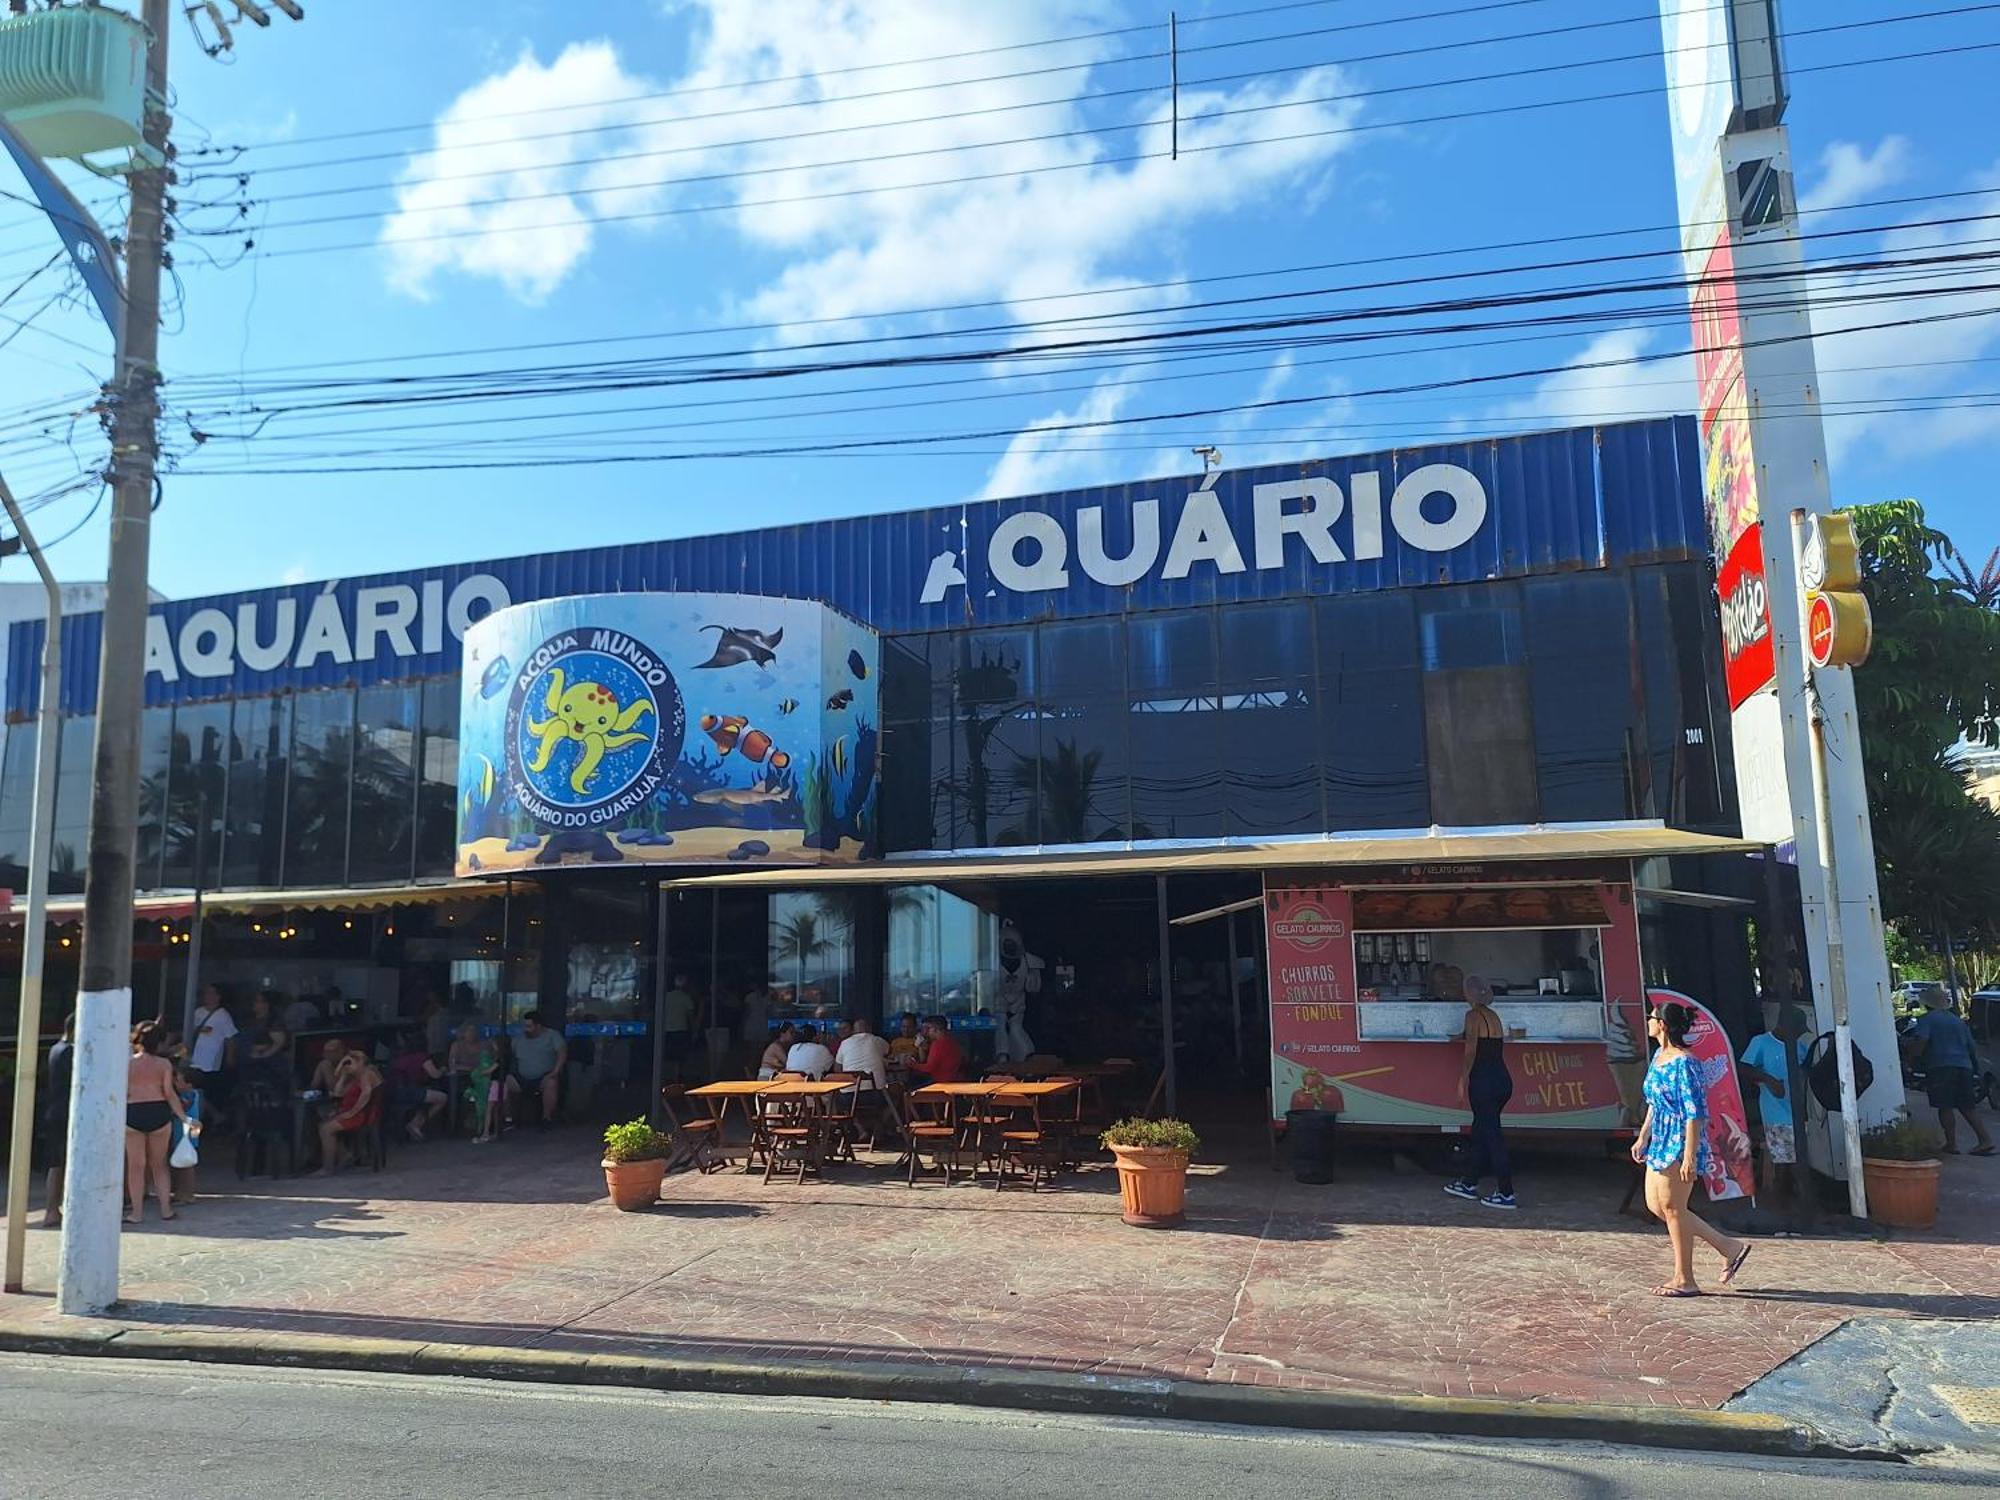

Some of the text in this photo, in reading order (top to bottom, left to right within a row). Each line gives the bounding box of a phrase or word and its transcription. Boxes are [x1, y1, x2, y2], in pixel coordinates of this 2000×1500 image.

[519, 635, 578, 691] ACQUA
[514, 773, 661, 827] AQUÁRIO DO GUARUJÁ
[1276, 924, 1304, 934] GELATO
[1281, 964, 1335, 984] CHURROS
[1287, 984, 1342, 1003] SORVETE
